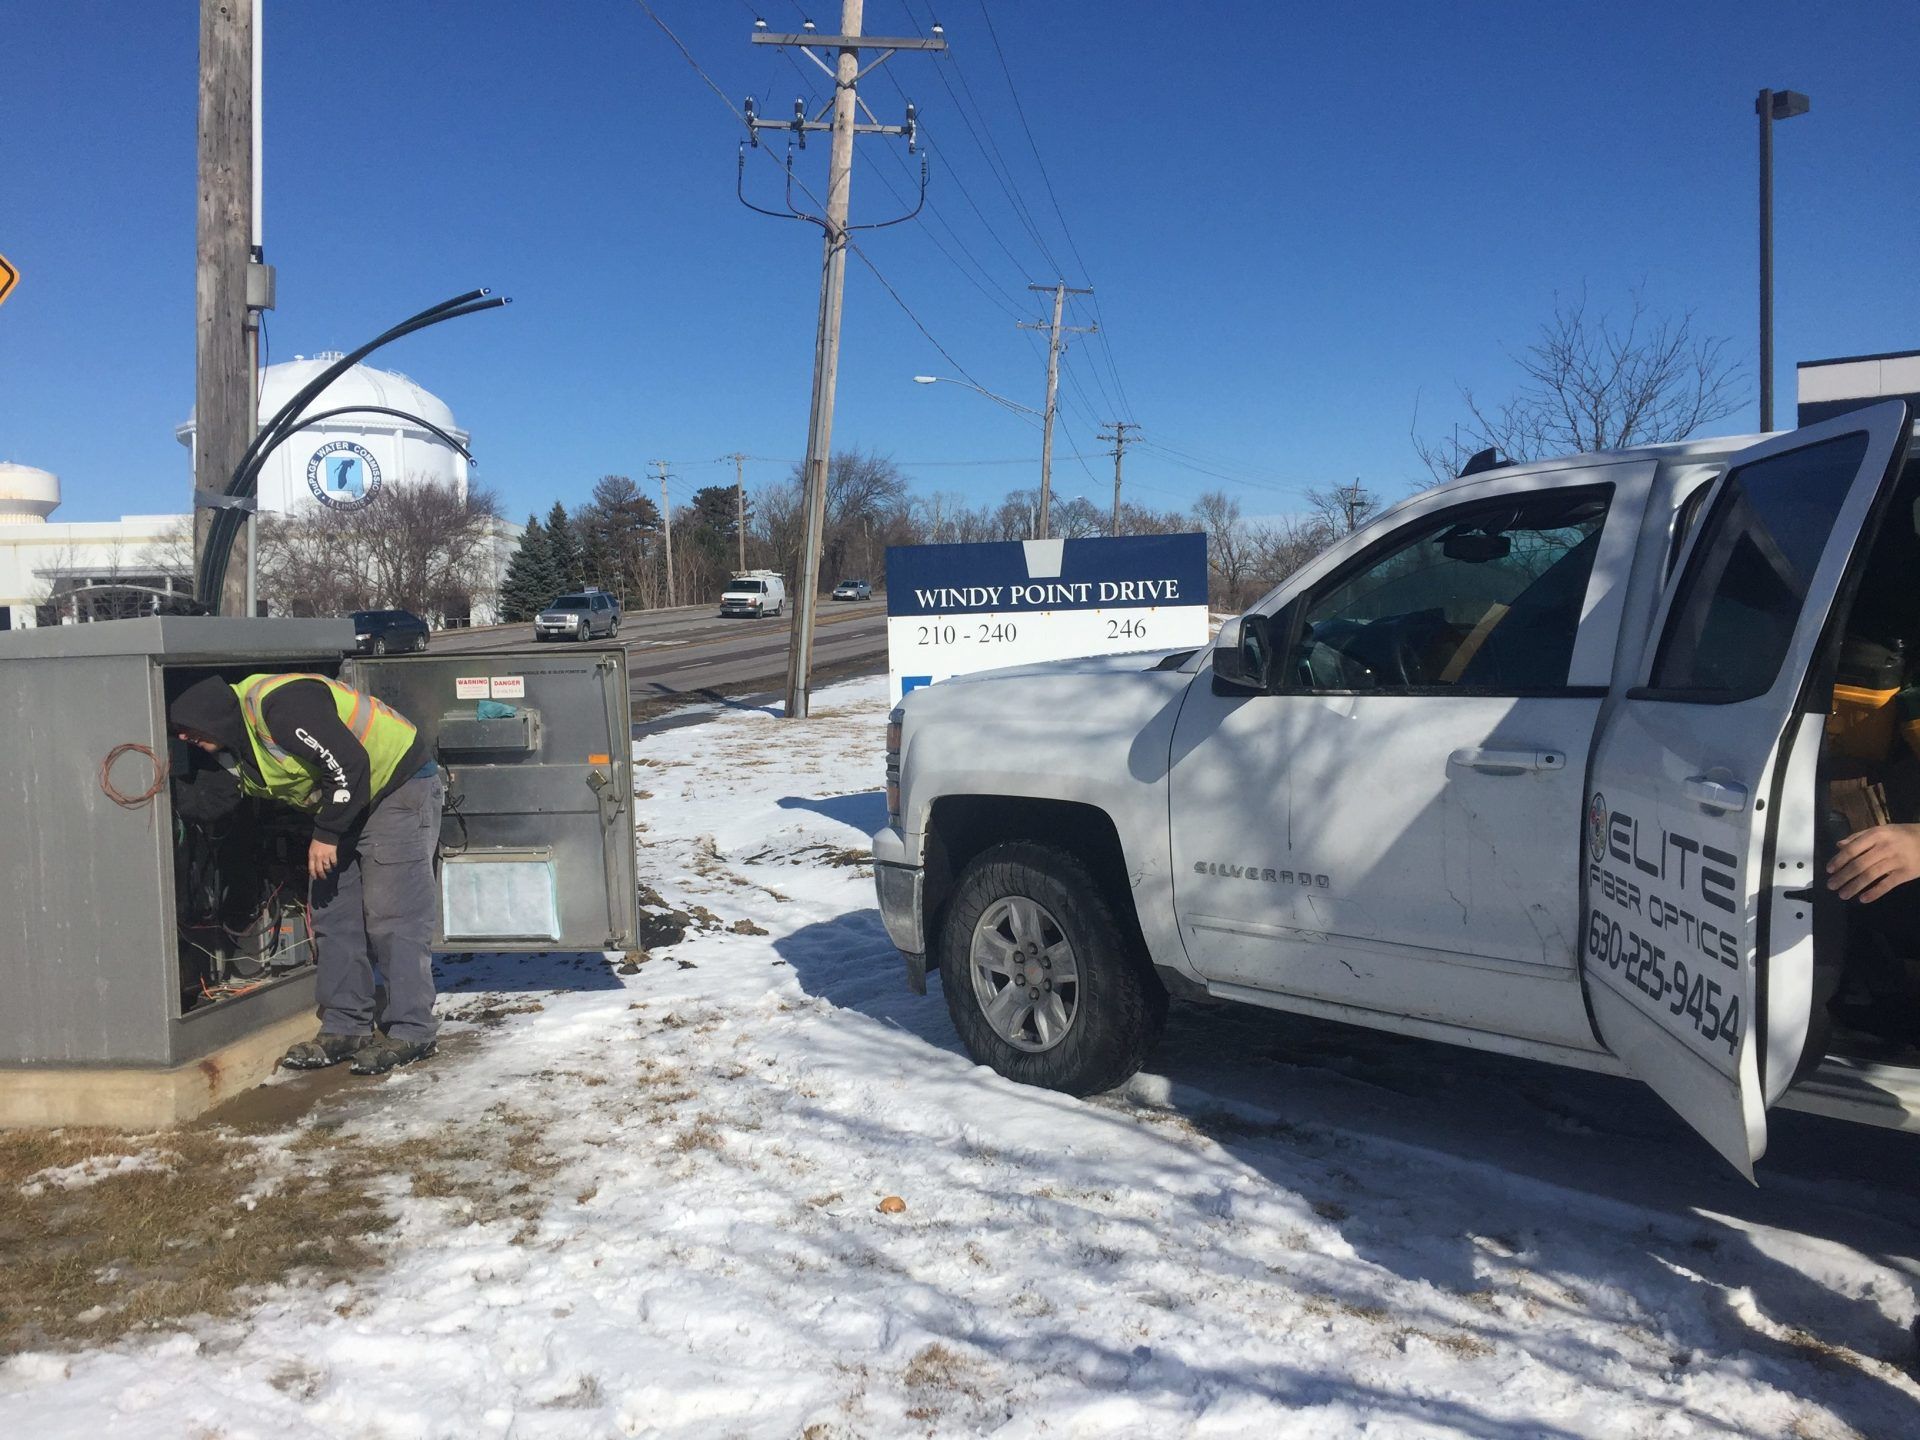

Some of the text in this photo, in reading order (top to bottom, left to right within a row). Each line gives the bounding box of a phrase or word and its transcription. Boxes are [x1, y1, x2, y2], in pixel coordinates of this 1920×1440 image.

[317, 442, 349, 458] WATER
[915, 579, 1180, 609] WINDY POINT DRIVE
[917, 624, 956, 646] 210
[978, 622, 1018, 644] 240
[1106, 617, 1147, 640] 246
[1193, 861, 1330, 888] SILVERADO
[1608, 811, 1738, 914] ELITE
[1589, 863, 1739, 970] FIBER OPTICS
[1589, 909, 1740, 1056] 630-225-9454
